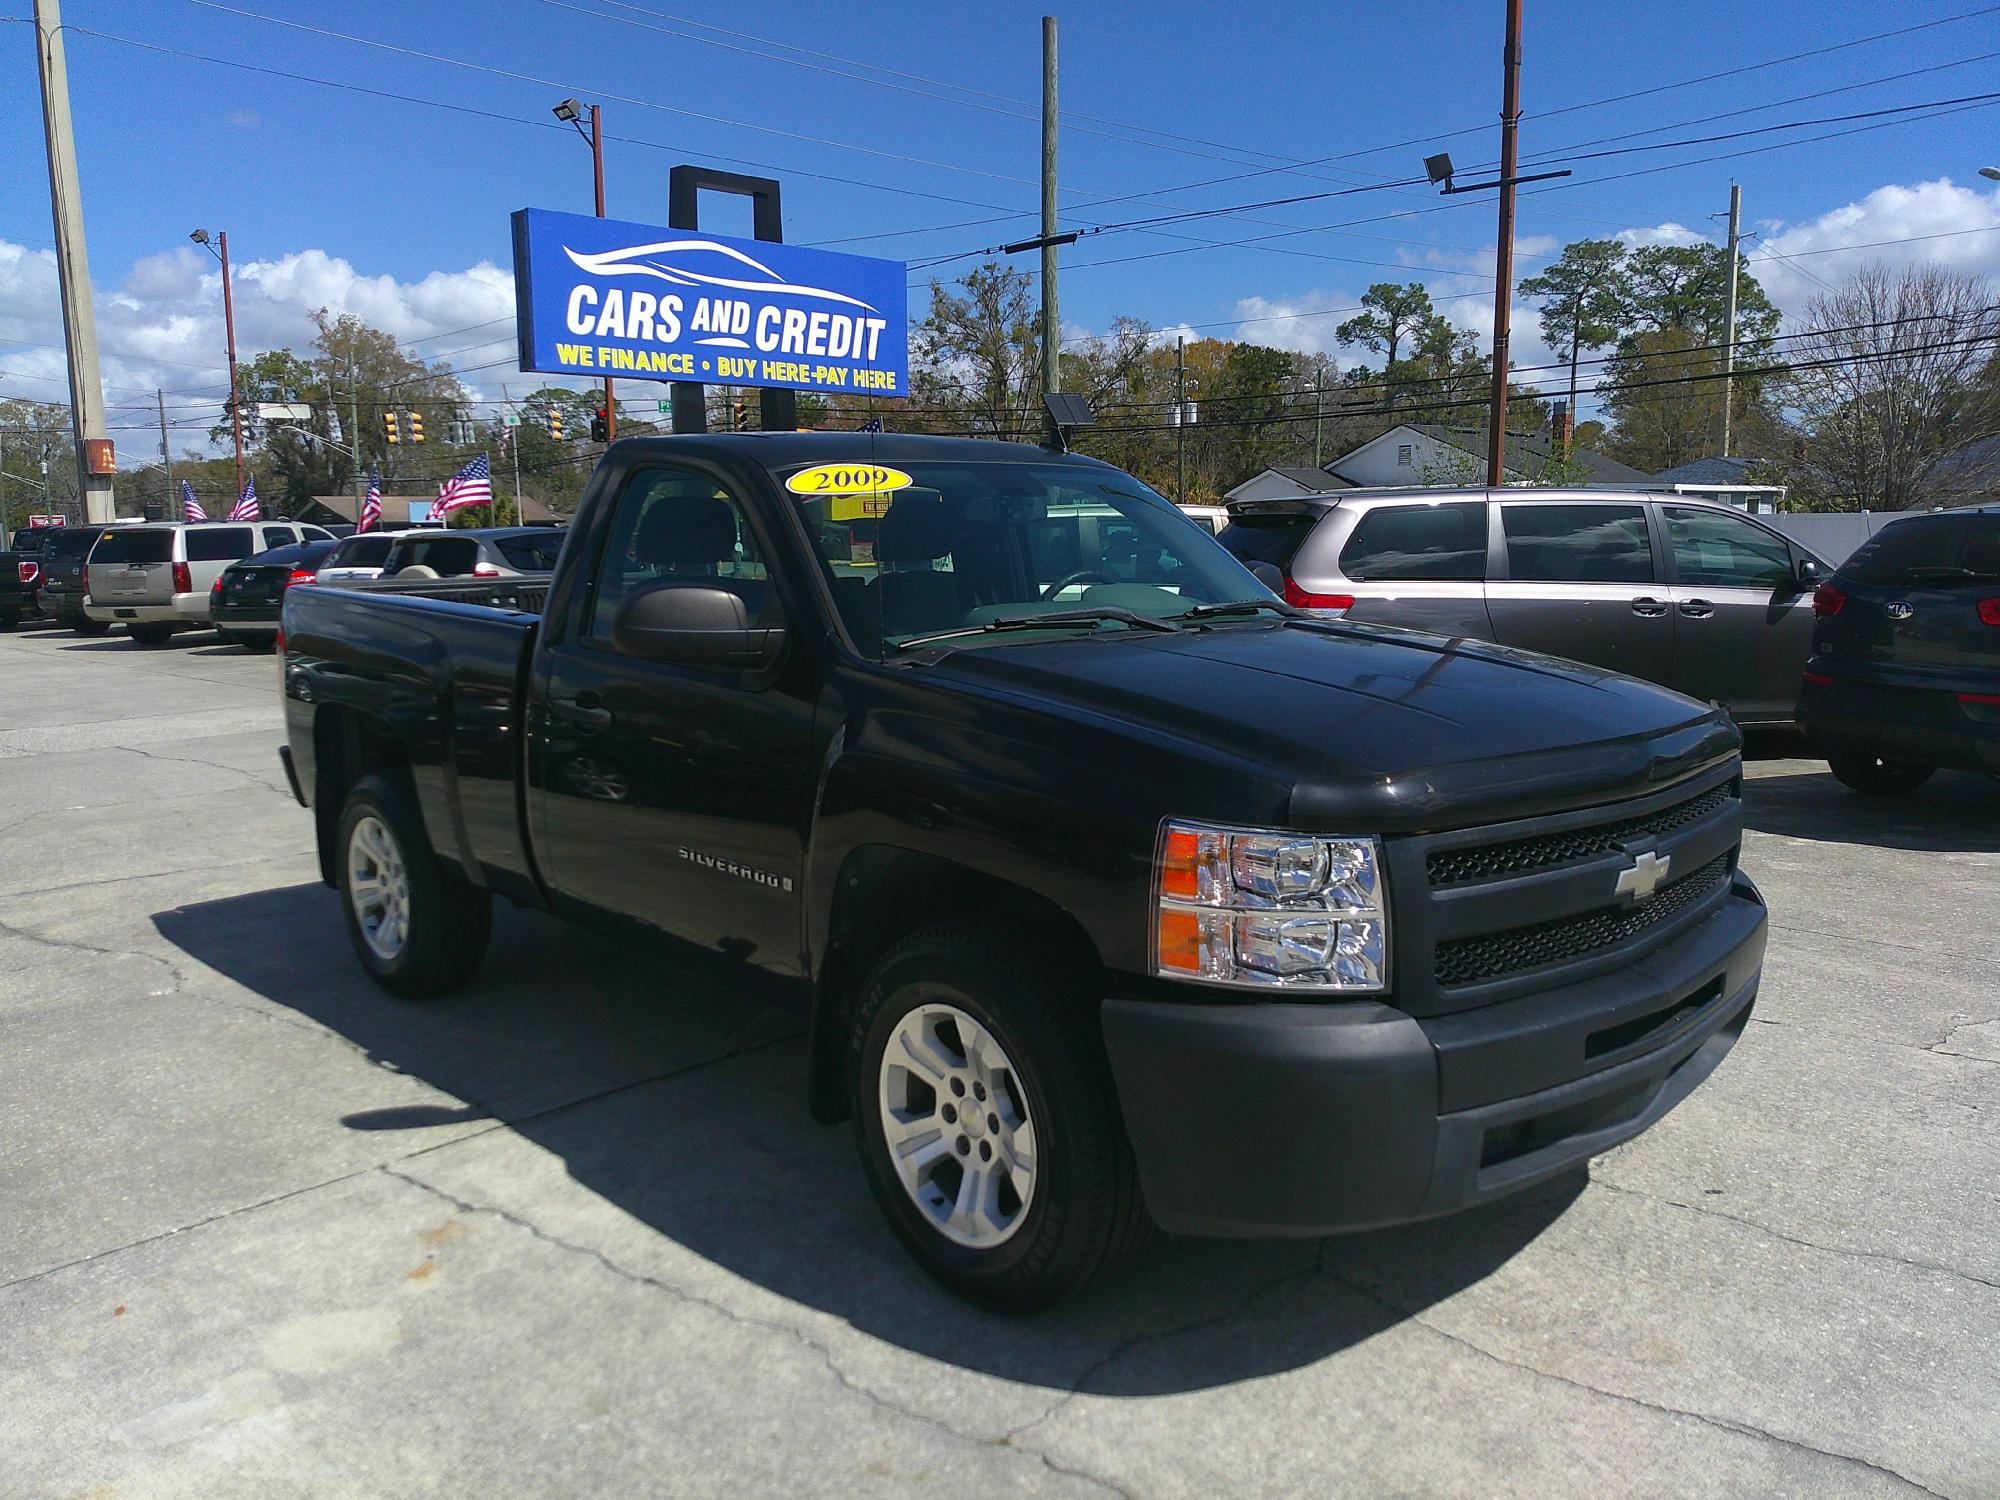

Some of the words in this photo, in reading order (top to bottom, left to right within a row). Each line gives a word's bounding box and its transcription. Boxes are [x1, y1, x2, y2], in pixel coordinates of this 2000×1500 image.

[567, 284, 684, 343] CARS
[690, 297, 751, 335] AND
[755, 305, 886, 361] CREDIT
[556, 343, 594, 367] WE
[598, 346, 695, 374] FINANCE
[717, 356, 757, 378] BUY
[853, 368, 896, 390] HERE
[814, 470, 889, 491] 2009
[679, 845, 779, 888] SILVERADO
